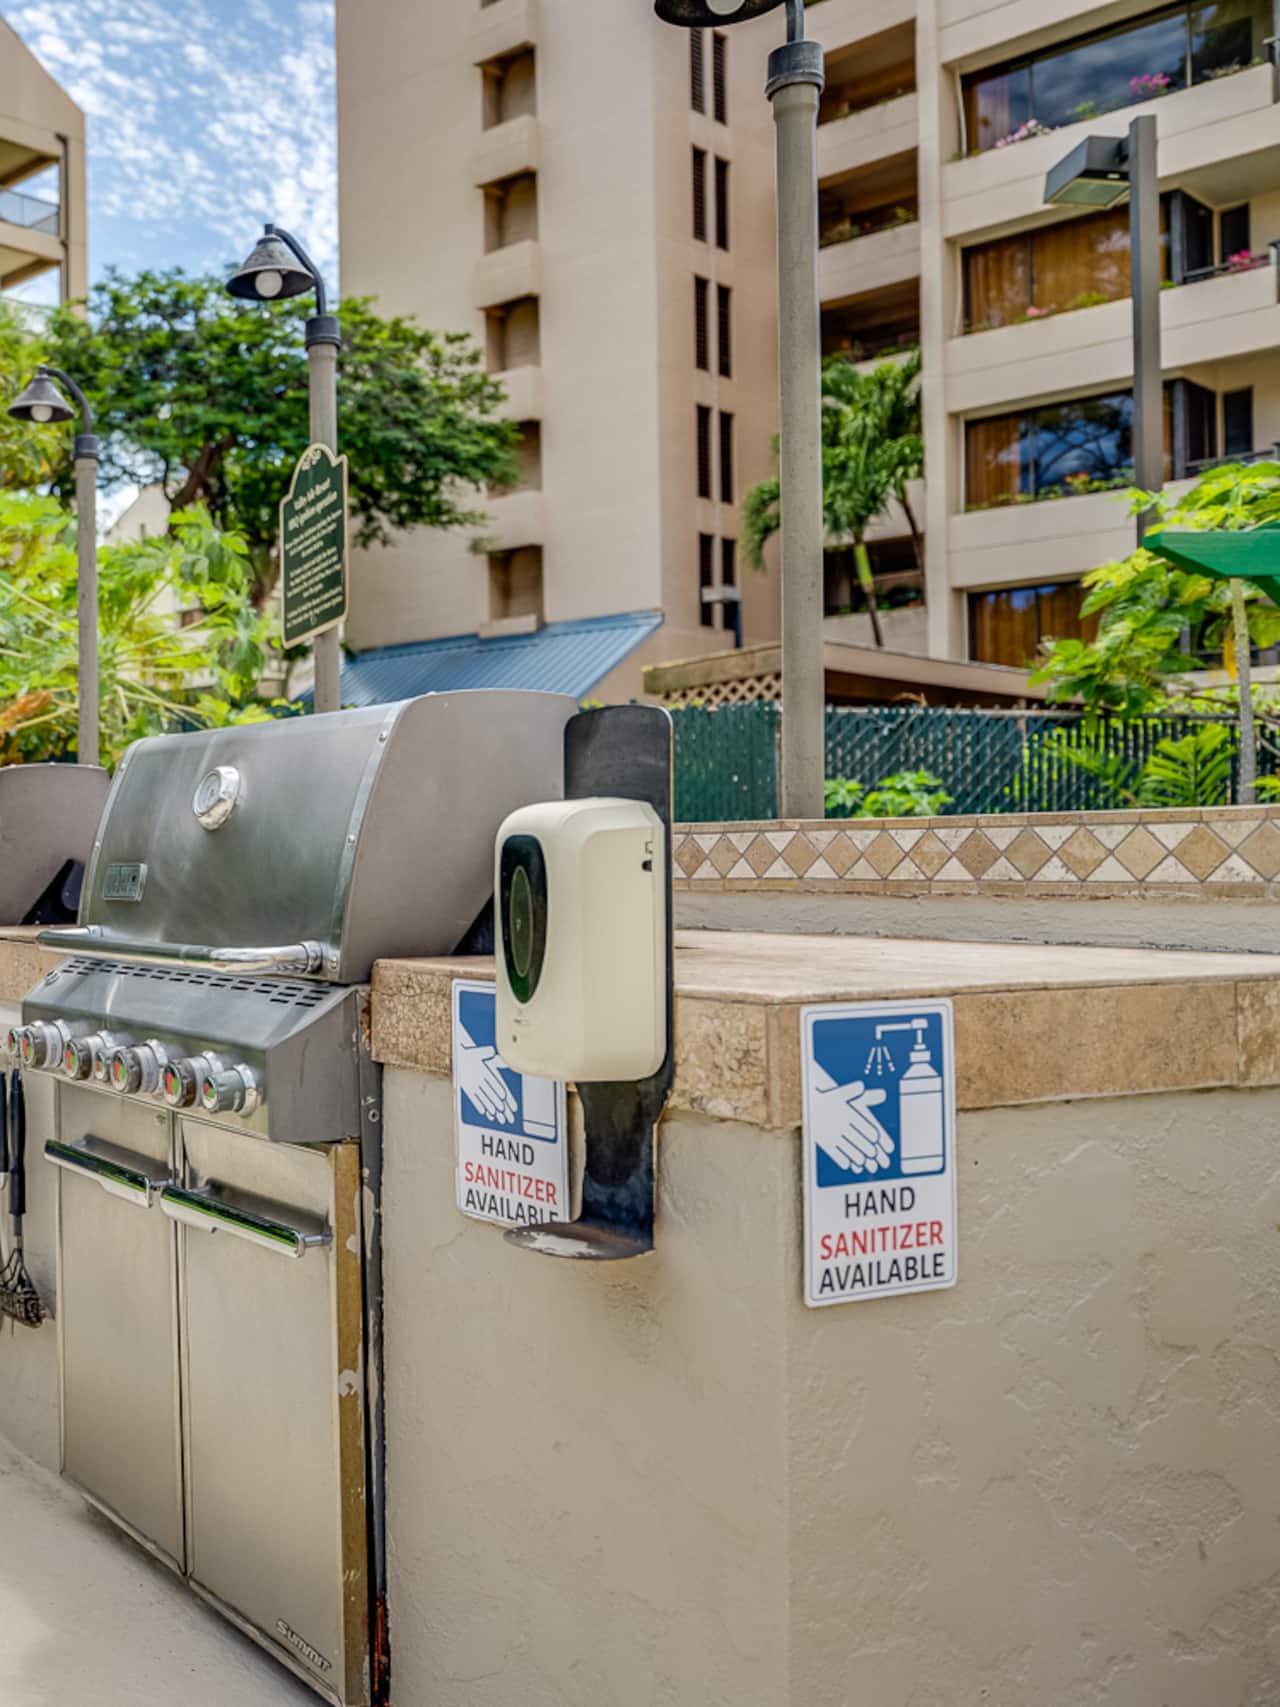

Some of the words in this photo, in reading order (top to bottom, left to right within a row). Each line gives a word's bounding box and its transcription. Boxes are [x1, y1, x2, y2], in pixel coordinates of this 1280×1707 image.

[481, 1134, 535, 1166] HAND
[464, 1161, 558, 1206] SANITIZER
[844, 1186, 916, 1219] HAND
[820, 1220, 944, 1261] SANITIZER
[819, 1253, 945, 1295] AVAILABLE
